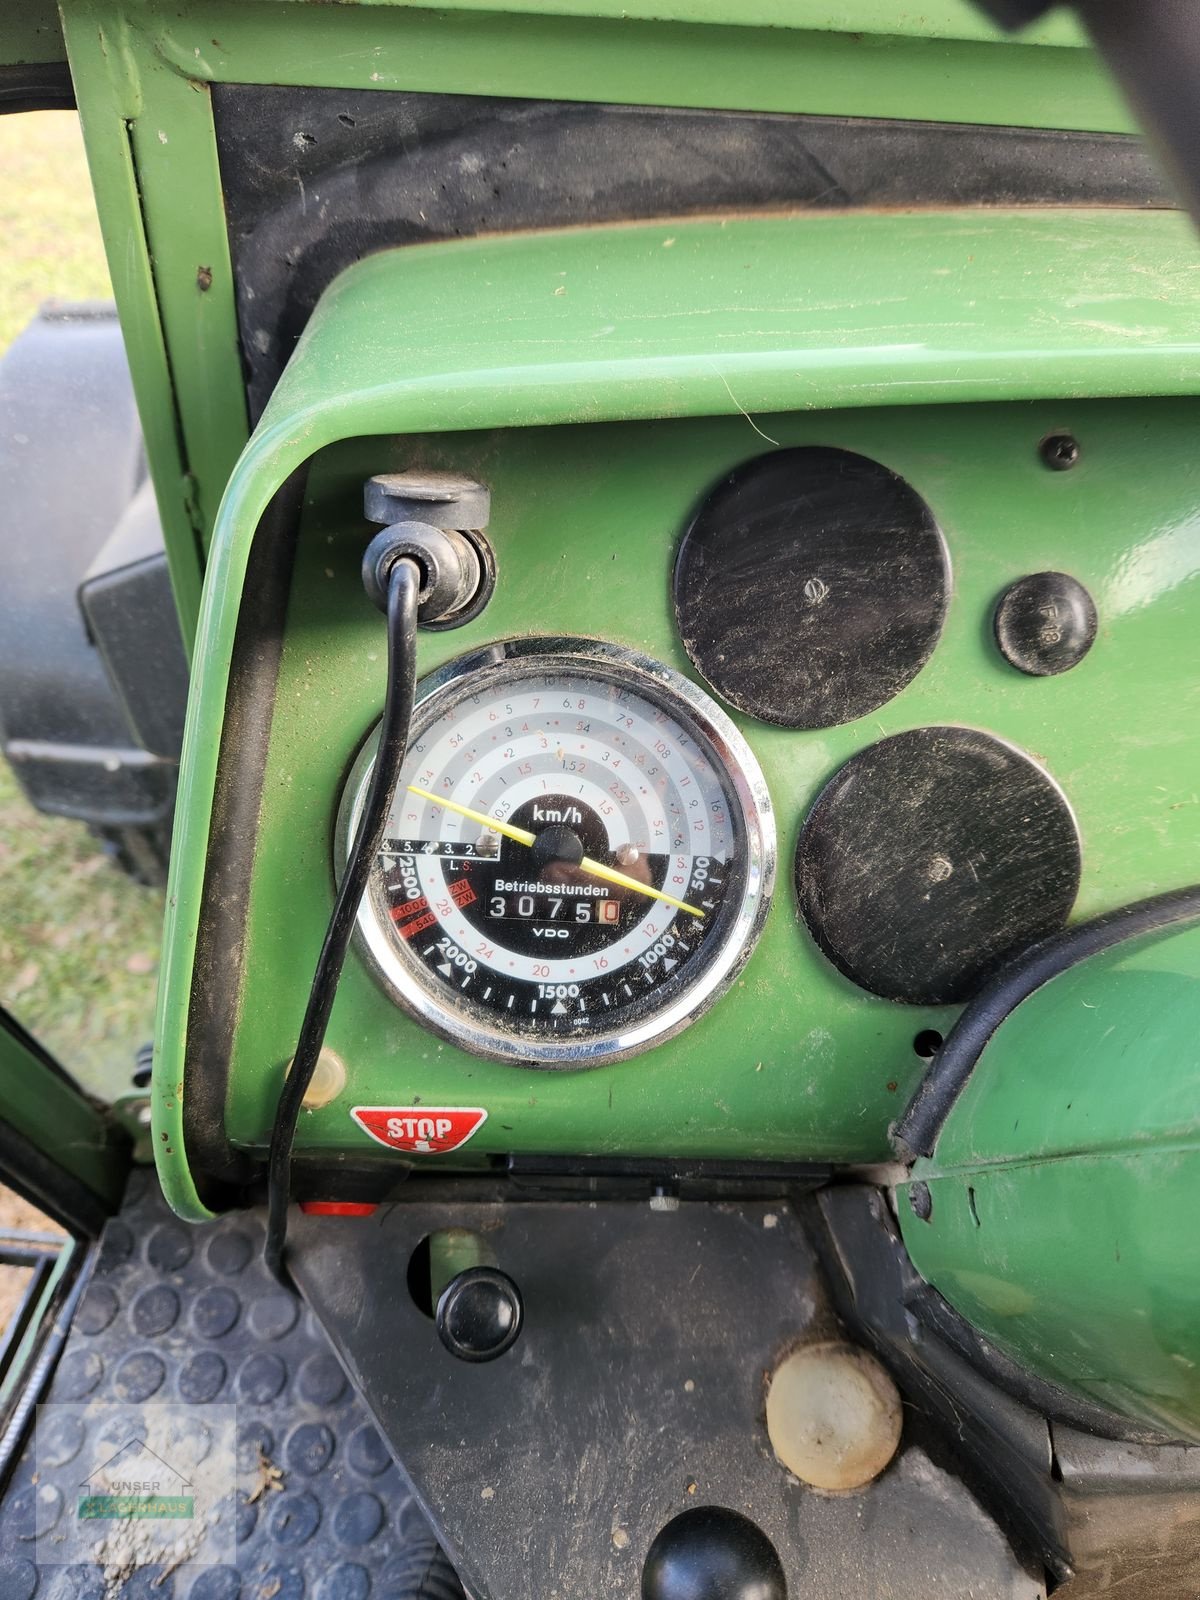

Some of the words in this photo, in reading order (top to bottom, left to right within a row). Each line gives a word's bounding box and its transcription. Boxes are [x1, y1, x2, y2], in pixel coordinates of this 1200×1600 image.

[505, 703, 513, 715] 5
[533, 698, 540, 709] 7
[562, 698, 573, 709] 6.
[577, 699, 585, 710] 8
[504, 726, 513, 737] 3
[522, 722, 529, 731] 4
[541, 738, 548, 748] 3
[676, 733, 689, 746] 14
[506, 748, 516, 758] 2
[601, 751, 611, 762] 3
[518, 762, 532, 776] 1.5
[612, 759, 621, 768] 4
[473, 771, 484, 782] 2
[647, 767, 658, 776] 5
[444, 776, 455, 786] 2
[680, 776, 691, 788] 11
[494, 801, 511, 819] 0.5
[599, 799, 613, 815] 1.5
[407, 812, 418, 821] 3
[533, 804, 582, 824] km/h
[693, 819, 704, 831] 12
[404, 841, 414, 852] 5.
[444, 843, 454, 854] 3.
[465, 844, 476, 856] 2.
[400, 856, 421, 899] 2500
[672, 875, 684, 884] 8
[691, 857, 710, 891] 500
[495, 879, 609, 897] Betriebsstunden
[400, 899, 427, 915] 1000
[437, 898, 453, 917] 28
[416, 913, 435, 928] 540
[532, 928, 569, 938] VDO
[642, 923, 658, 938] 12
[436, 937, 478, 974] 2000
[476, 943, 494, 959] 24
[638, 934, 675, 969] 1000
[593, 956, 609, 970] 16
[532, 964, 550, 977] 20
[538, 984, 580, 999] 1500
[387, 1118, 452, 1139] STOP
